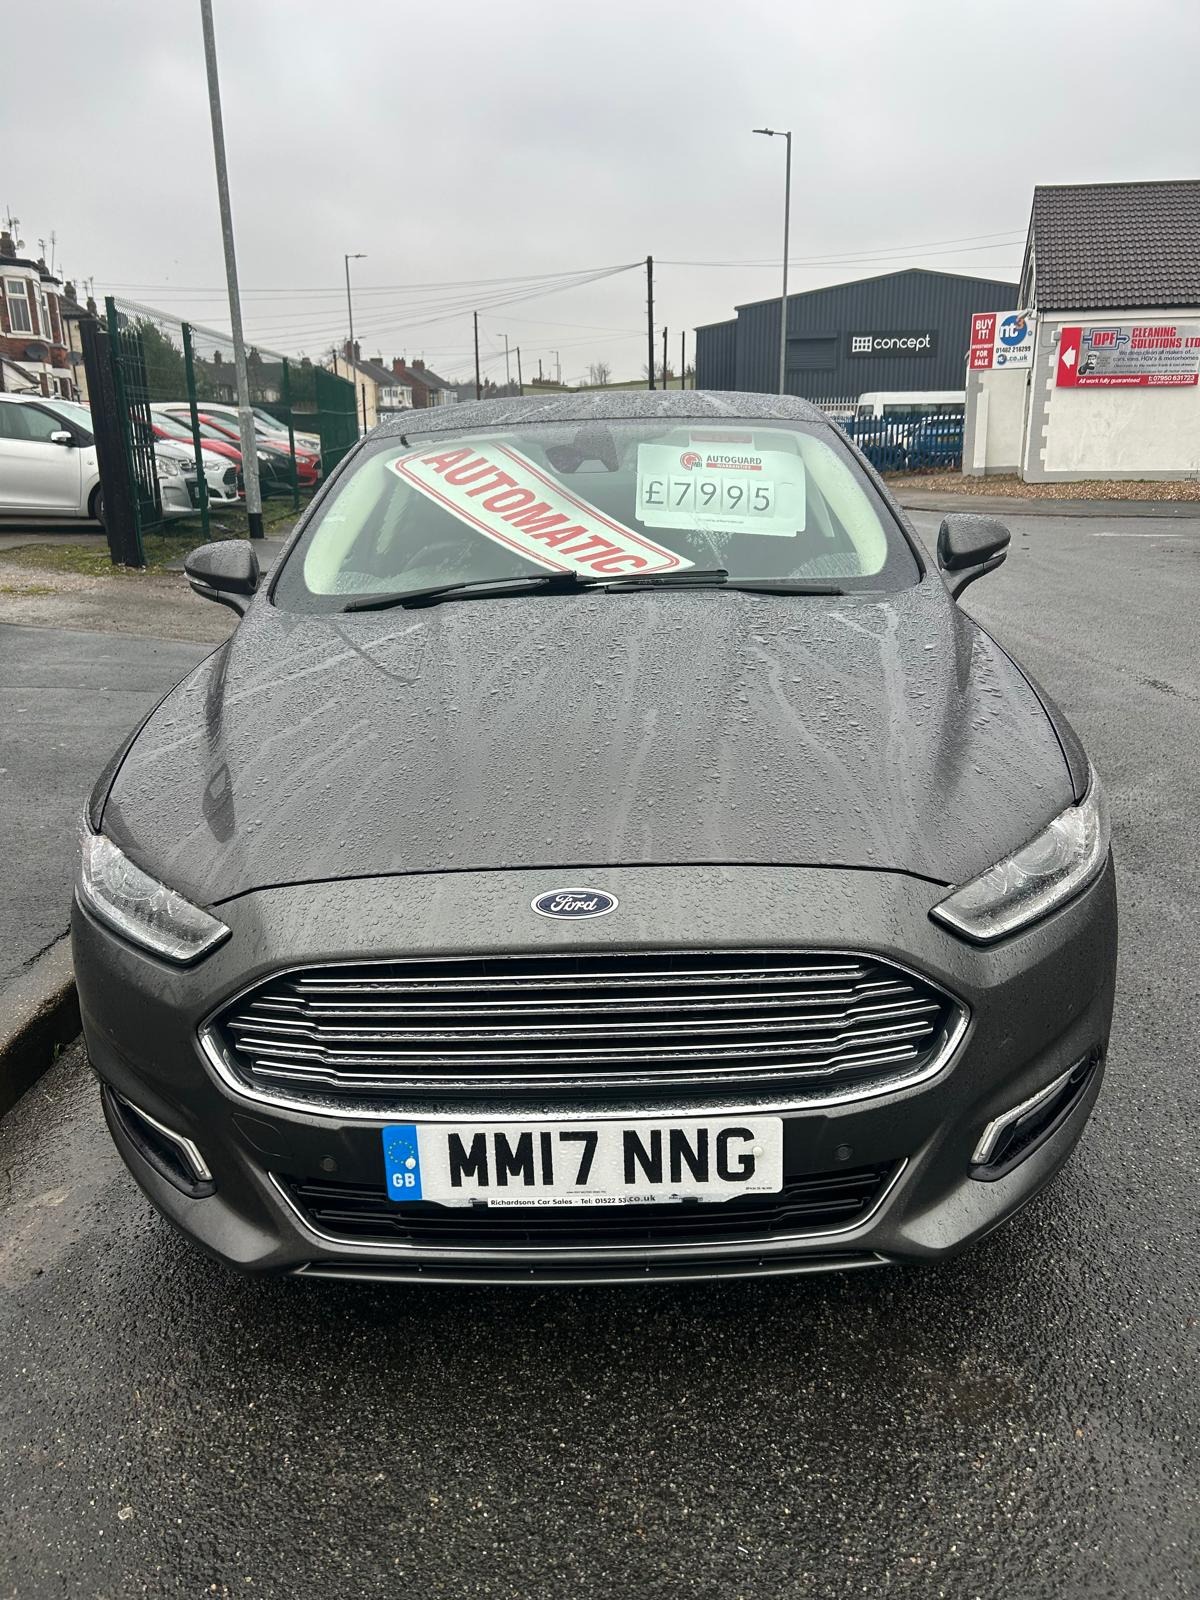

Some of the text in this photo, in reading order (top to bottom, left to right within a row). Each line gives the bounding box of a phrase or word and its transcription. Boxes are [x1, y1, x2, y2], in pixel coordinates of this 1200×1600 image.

[976, 319, 993, 330] BUY
[978, 330, 989, 339] IT!
[1093, 332, 1116, 346] DPF
[1132, 327, 1176, 338] CLEANING
[873, 334, 930, 351] concept
[1130, 338, 1200, 349] SOLUTIONS LTD
[1110, 377, 1140, 385] guaranteed
[706, 455, 762, 465] AUTOGUARD
[645, 481, 770, 511] £7995
[421, 447, 647, 573] AUTOMATIC
[550, 894, 599, 912] Ford
[447, 1127, 756, 1187] MM17 NNG
[392, 1173, 416, 1188] GB
